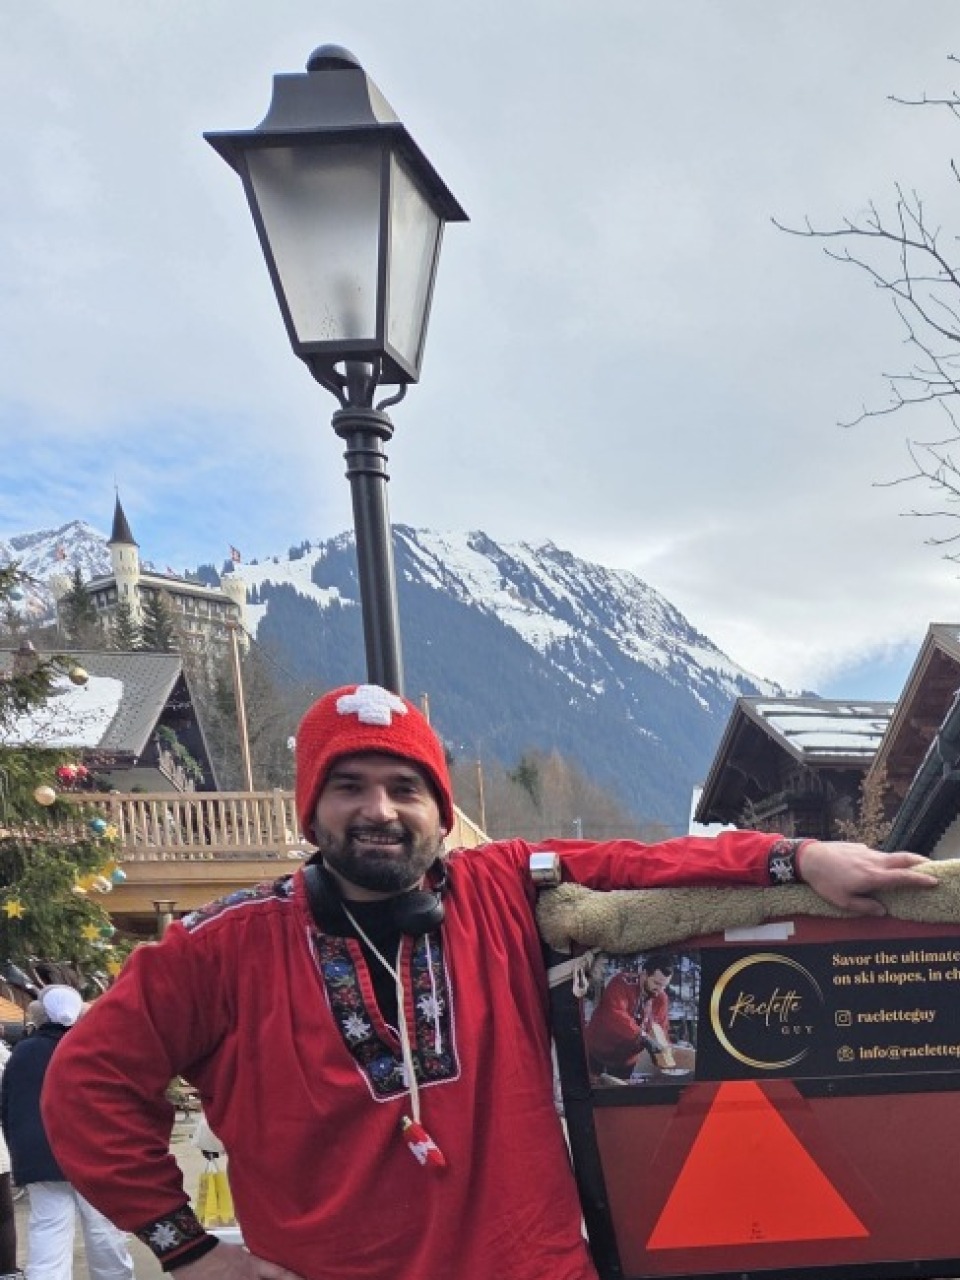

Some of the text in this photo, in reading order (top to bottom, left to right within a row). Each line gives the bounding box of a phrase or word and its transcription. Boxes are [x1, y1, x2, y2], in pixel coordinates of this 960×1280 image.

[832, 953, 872, 966] Savor
[875, 951, 898, 964] the
[832, 973, 851, 985] on
[854, 970, 875, 984] ski
[878, 969, 926, 985] slopes,
[928, 968, 942, 981] in
[729, 987, 802, 1028] Raclette
[857, 1008, 936, 1024] racletteguy
[781, 1025, 813, 1034] GUY
